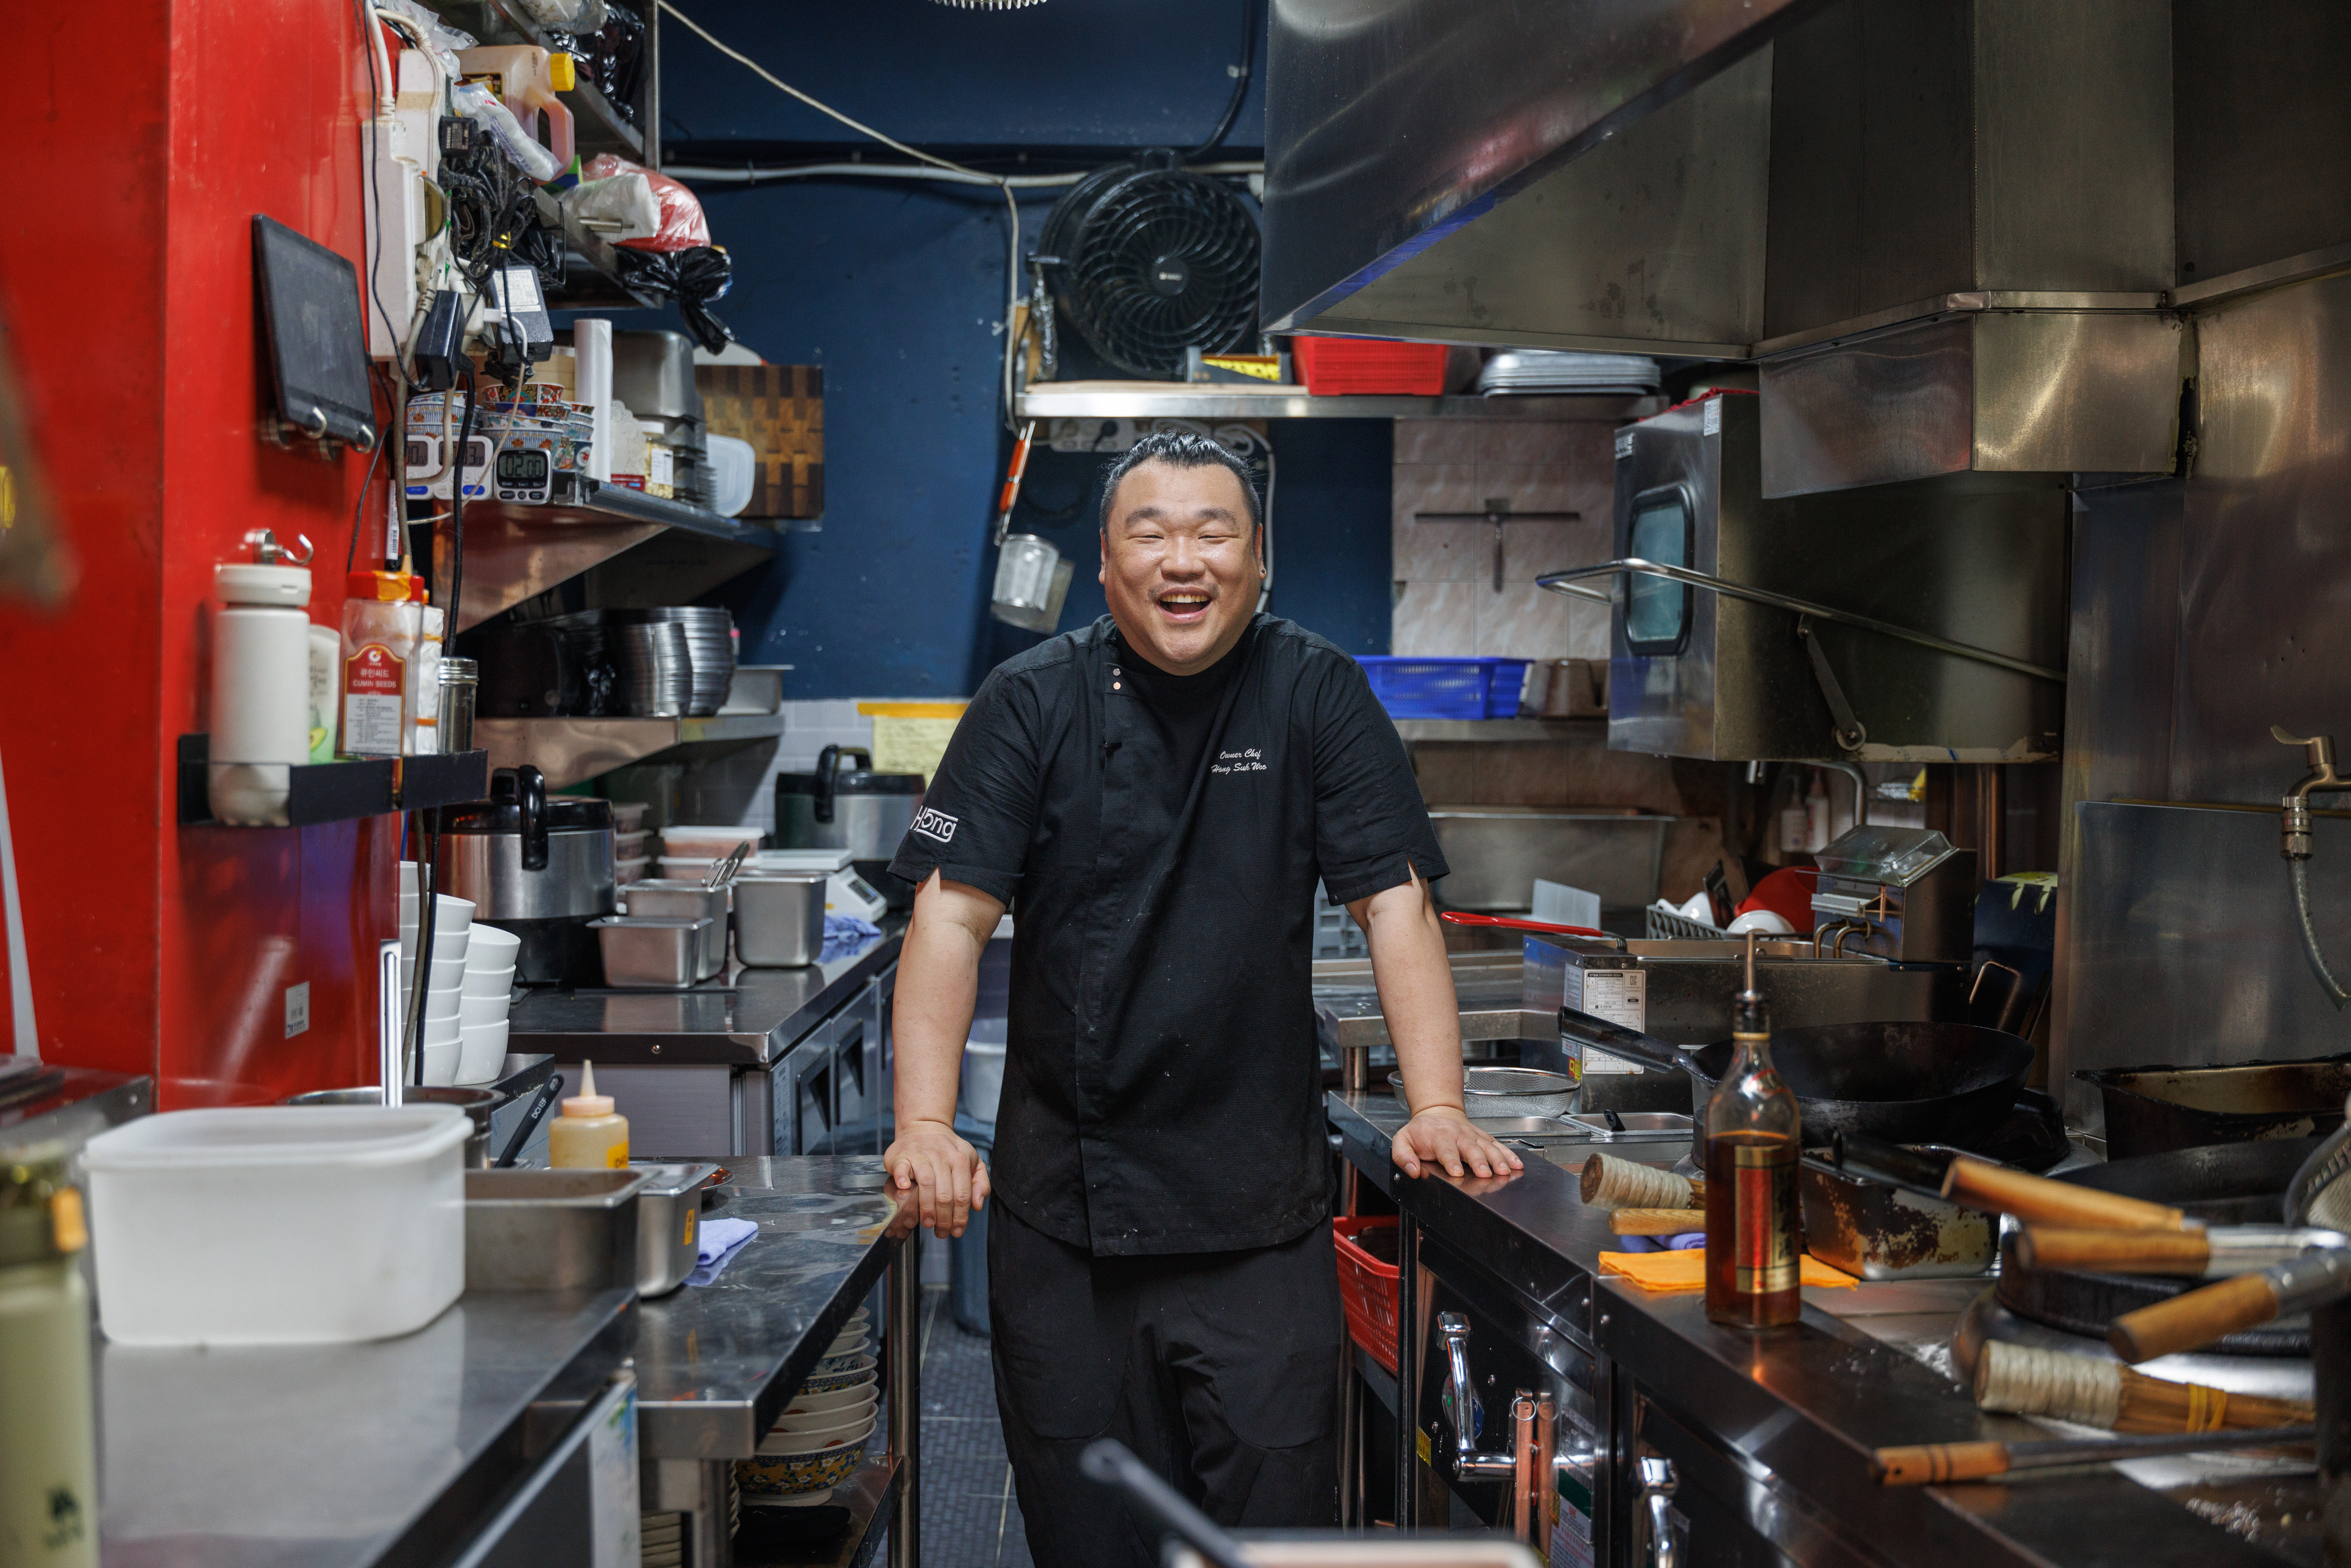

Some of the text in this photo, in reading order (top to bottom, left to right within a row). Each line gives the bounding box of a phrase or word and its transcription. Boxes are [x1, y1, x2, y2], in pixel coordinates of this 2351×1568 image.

[1220, 748, 1261, 759] Owner Chef
[1211, 762, 1267, 775] Hong Suk Woo
